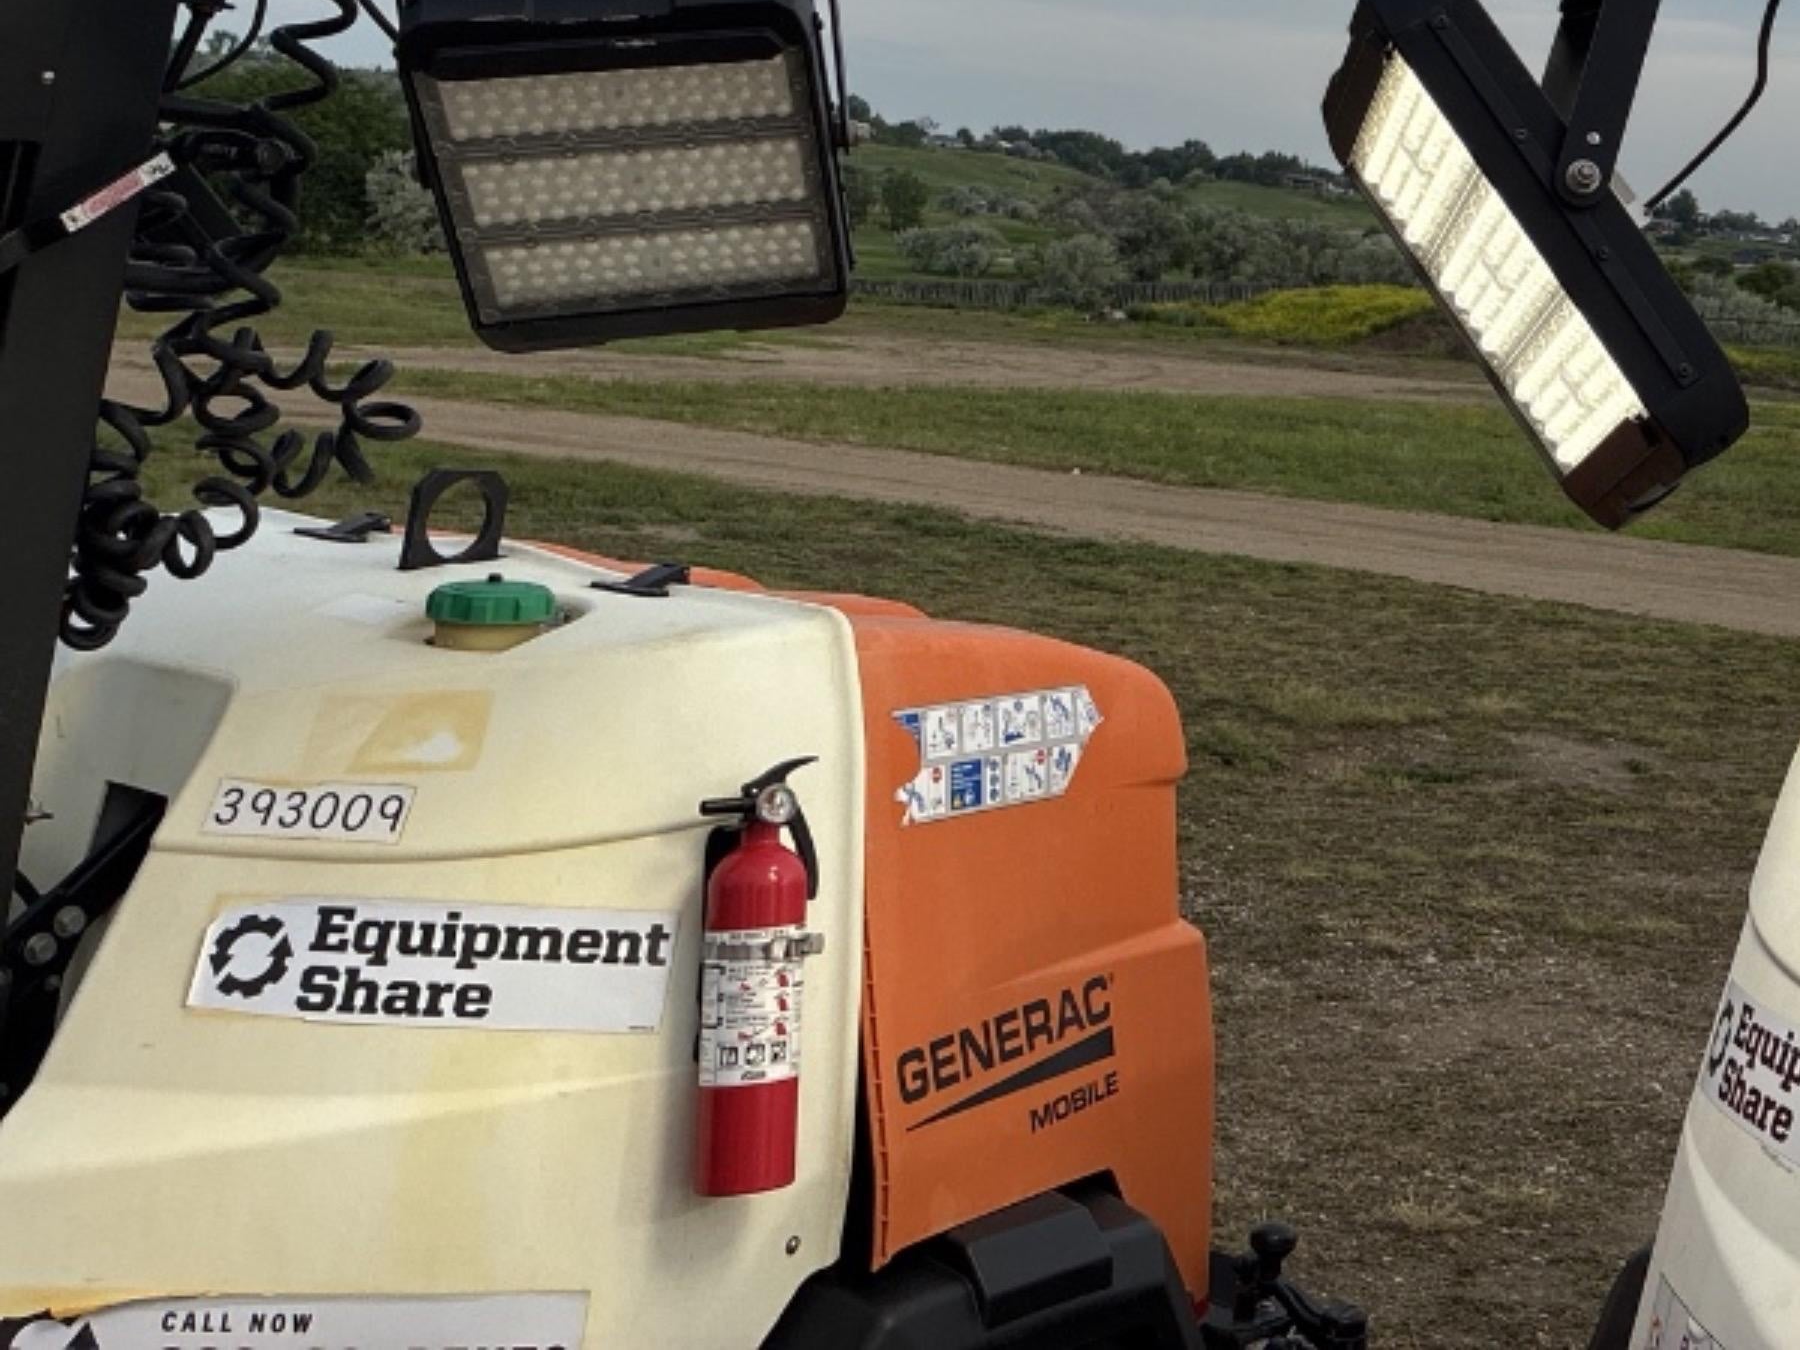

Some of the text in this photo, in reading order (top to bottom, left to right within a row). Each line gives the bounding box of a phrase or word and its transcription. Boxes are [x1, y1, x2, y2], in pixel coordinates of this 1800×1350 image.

[214, 788, 406, 833] 393009
[308, 905, 670, 970] Equipment
[296, 965, 492, 1019] Share
[897, 974, 1112, 1105] GENERAC
[1029, 1070, 1119, 1134] MOBILE
[1718, 1056, 1794, 1143] Share
[161, 1311, 314, 1334] CALL NOW
